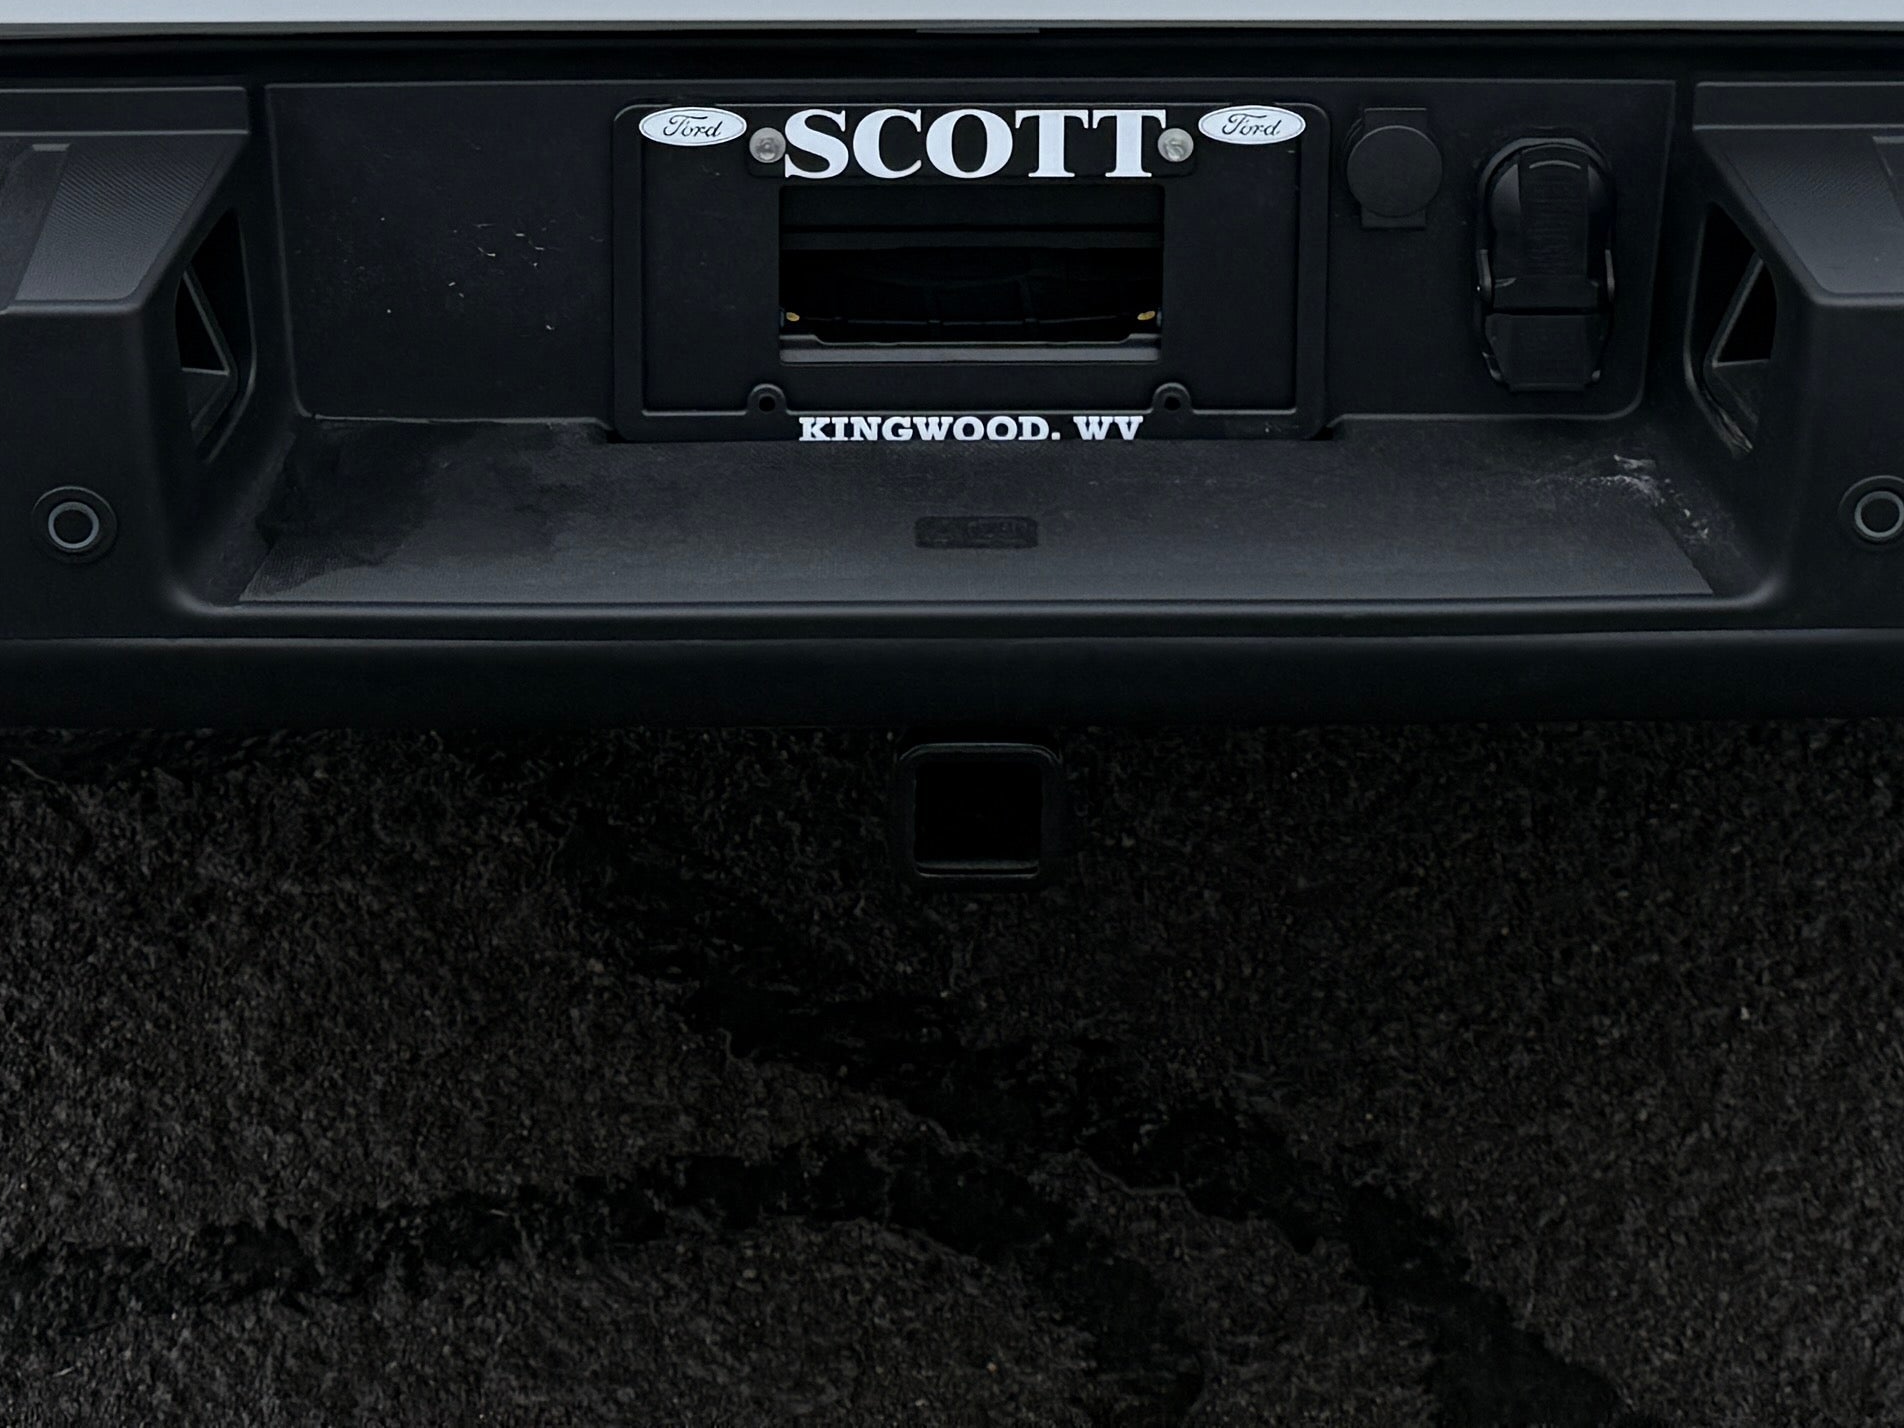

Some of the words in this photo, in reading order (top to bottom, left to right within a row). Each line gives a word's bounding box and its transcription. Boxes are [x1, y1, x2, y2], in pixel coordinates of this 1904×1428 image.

[662, 114, 724, 138] Ford
[1221, 112, 1283, 137] Ford
[784, 107, 1166, 179] SCOTT
[1072, 415, 1145, 441] WV
